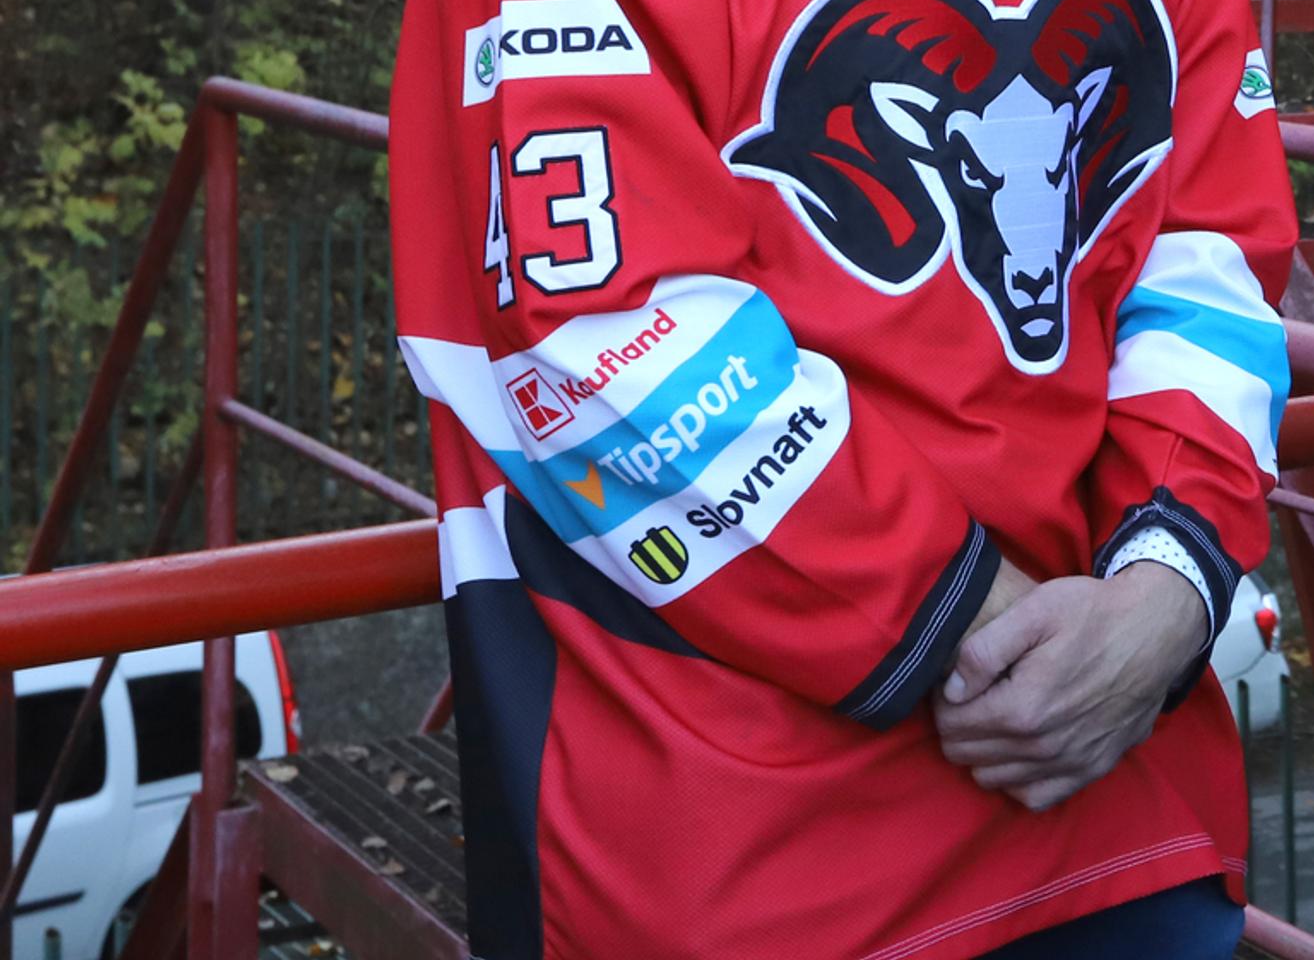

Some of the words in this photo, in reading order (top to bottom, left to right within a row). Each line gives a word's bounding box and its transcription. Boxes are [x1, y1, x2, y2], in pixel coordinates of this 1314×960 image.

[498, 24, 634, 59] KODA
[483, 124, 624, 312] 43
[564, 308, 678, 407] Kaufland
[598, 353, 760, 486] Tipsport
[686, 403, 828, 540] Slovnaft
